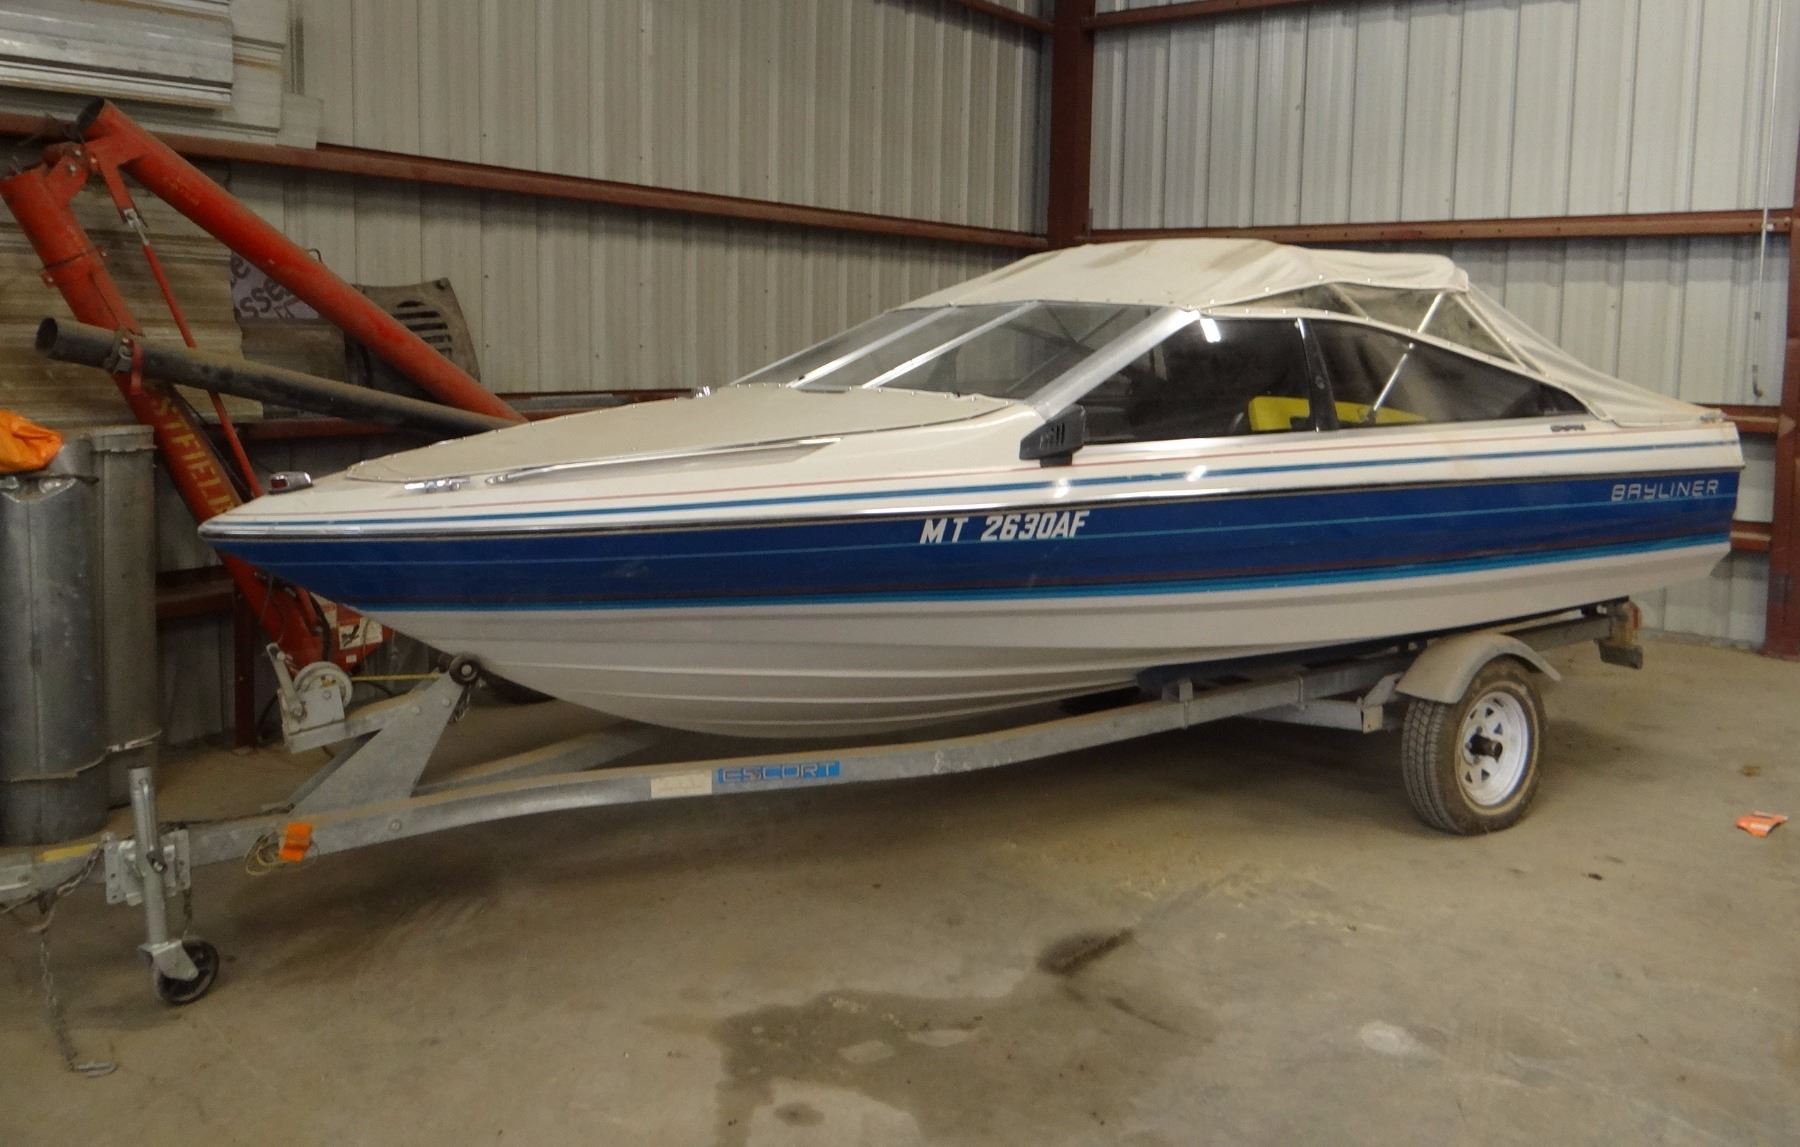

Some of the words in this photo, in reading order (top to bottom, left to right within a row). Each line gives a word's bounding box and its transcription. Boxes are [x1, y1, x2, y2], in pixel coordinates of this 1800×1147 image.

[1611, 479, 1719, 502] BAYLINER
[980, 510, 1090, 542] 2630AF
[721, 761, 839, 784] ESCORT
